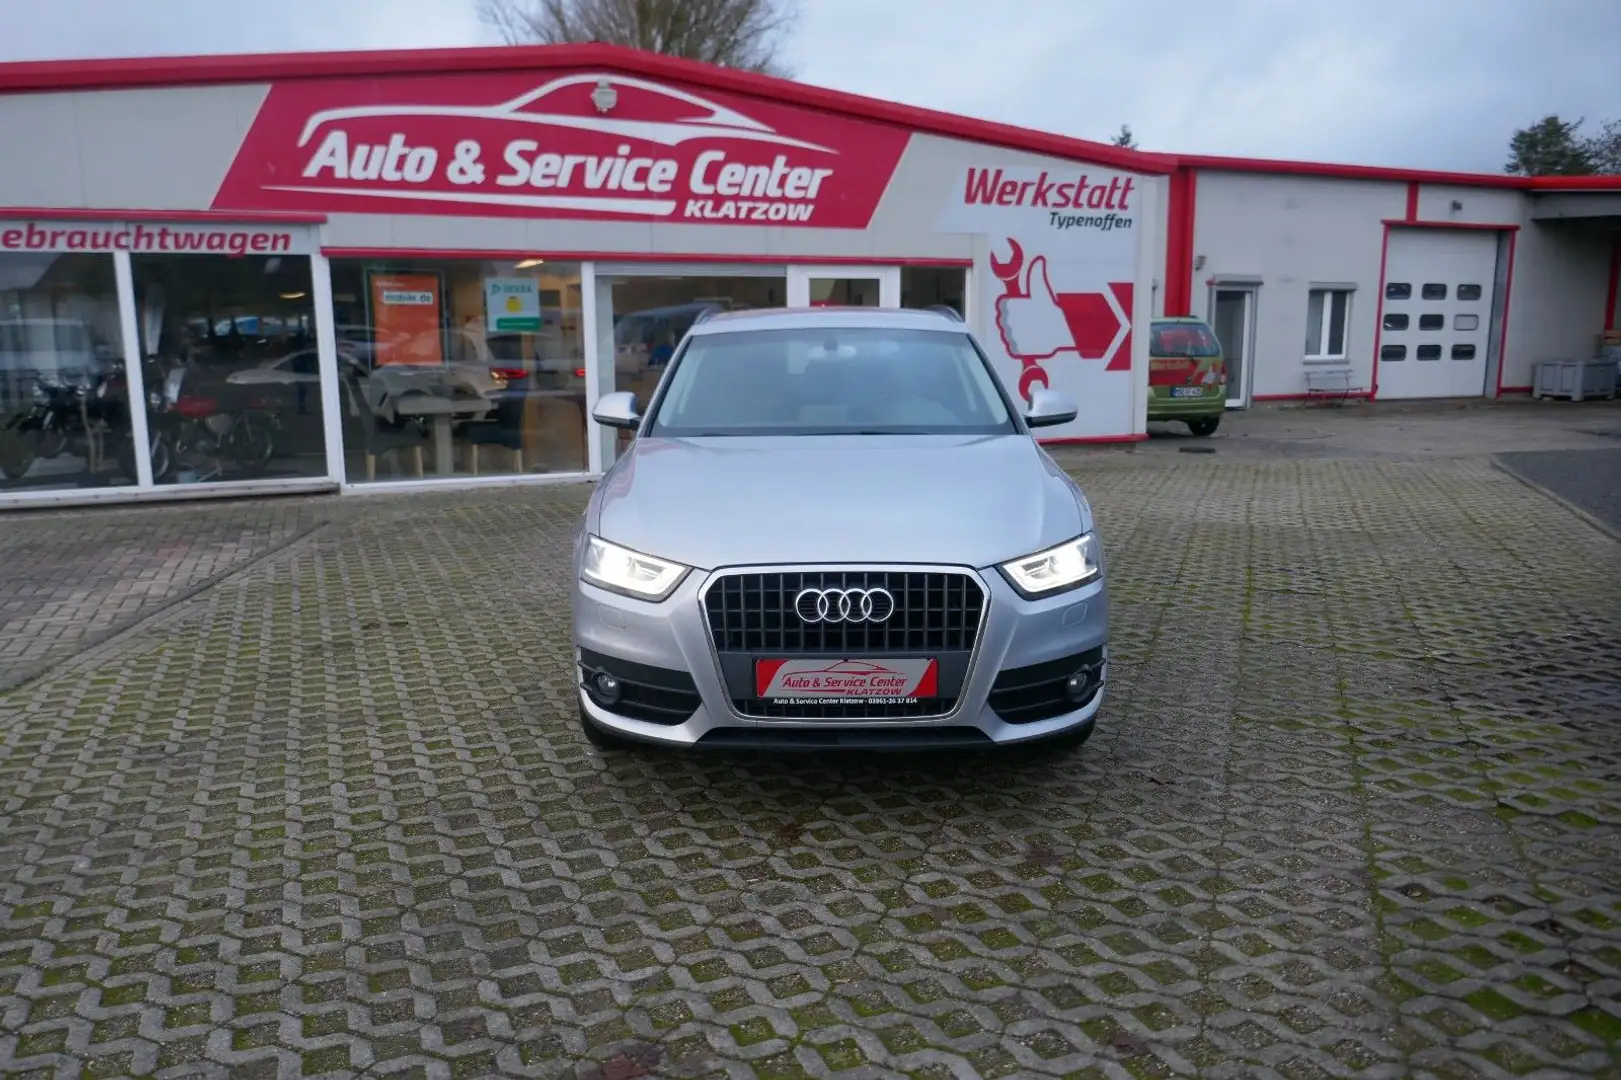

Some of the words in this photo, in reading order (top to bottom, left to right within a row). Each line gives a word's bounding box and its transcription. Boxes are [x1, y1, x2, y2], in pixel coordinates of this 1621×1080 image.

[302, 130, 438, 182] Auto
[447, 140, 486, 184] &
[496, 139, 679, 193] Service
[690, 150, 833, 199] Center
[964, 167, 1135, 210] Werkstatt
[684, 200, 814, 221] KLATZOW
[1050, 211, 1132, 231] Typenoffen
[782, 677, 810, 688] Auto
[812, 678, 820, 687] &
[823, 677, 866, 688] Service
[869, 677, 907, 687] Center
